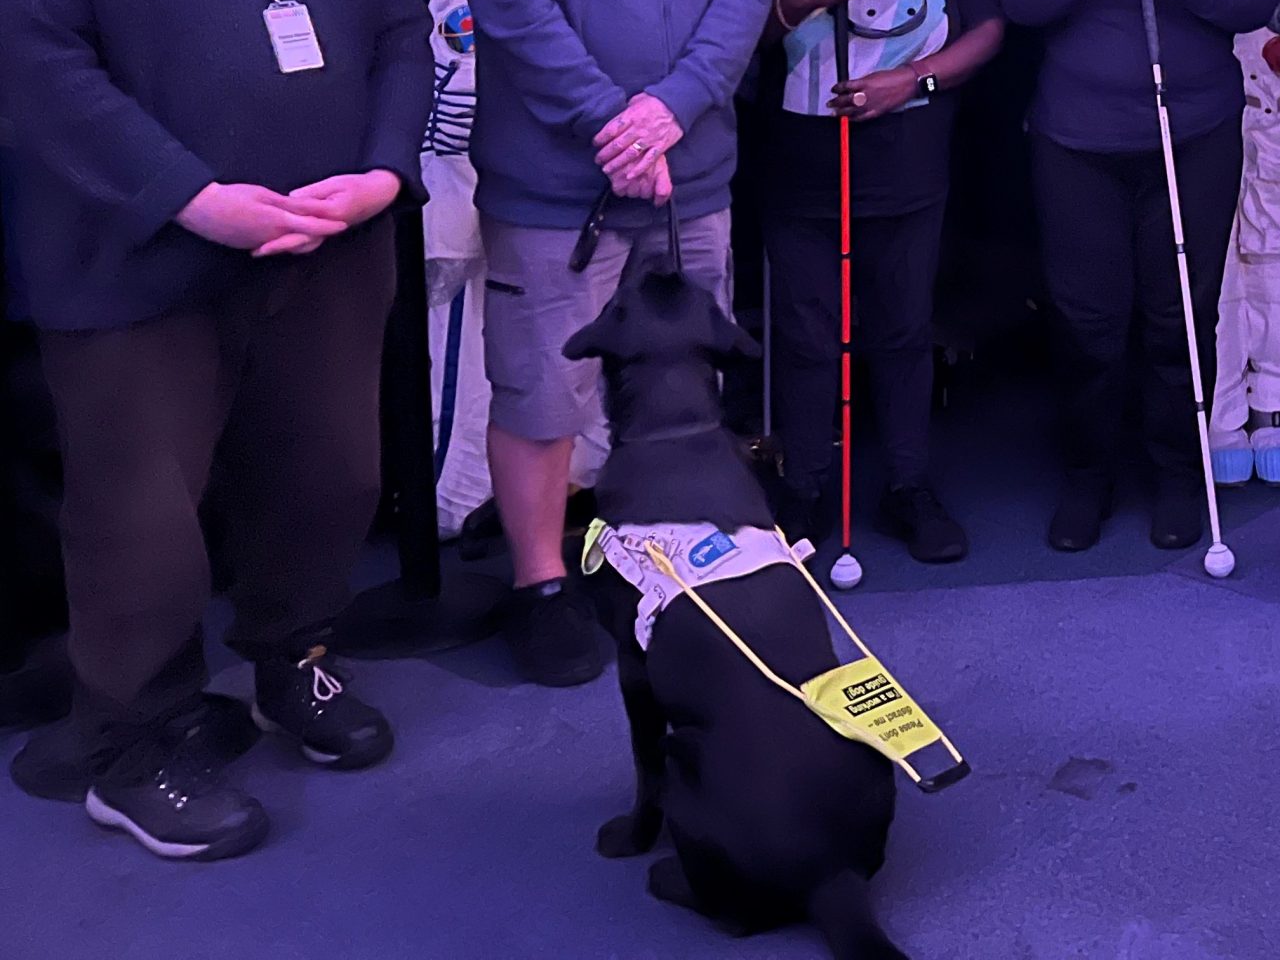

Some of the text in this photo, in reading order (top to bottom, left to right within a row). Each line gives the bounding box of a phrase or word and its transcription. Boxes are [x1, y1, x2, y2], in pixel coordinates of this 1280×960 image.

[865, 675, 887, 690] guide
[848, 697, 881, 714] working
[886, 705, 912, 722] distract
[874, 717, 887, 726] me
[899, 719, 923, 732] Please
